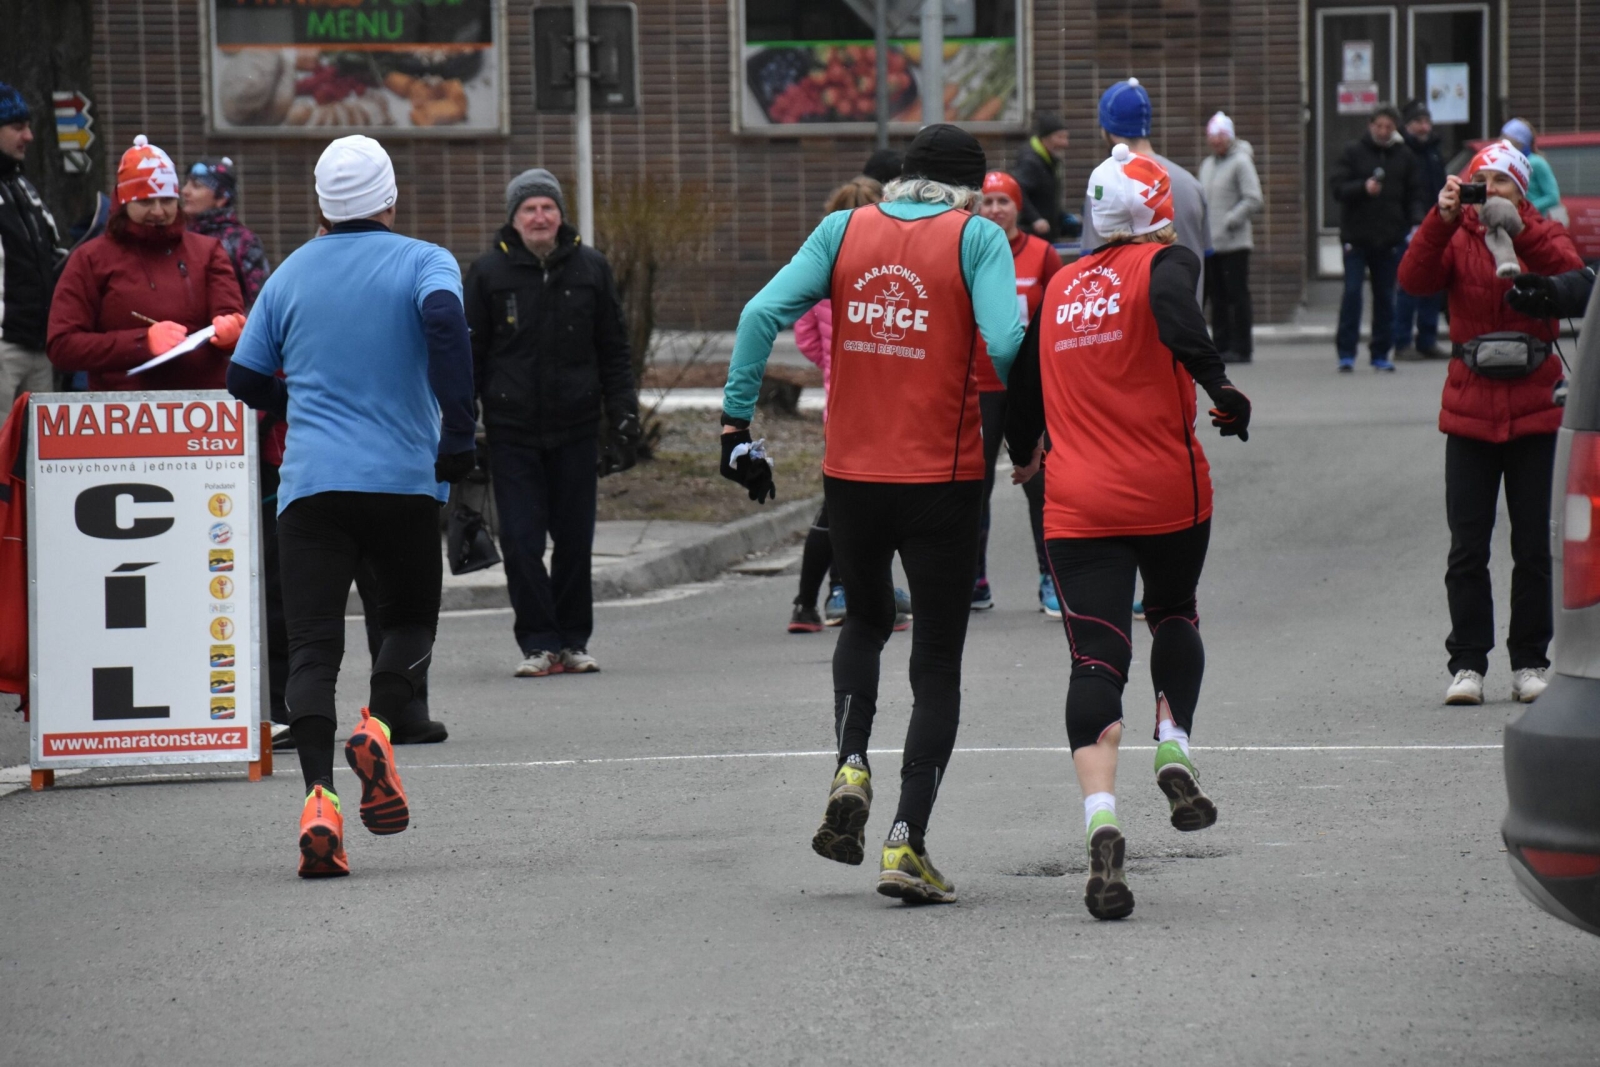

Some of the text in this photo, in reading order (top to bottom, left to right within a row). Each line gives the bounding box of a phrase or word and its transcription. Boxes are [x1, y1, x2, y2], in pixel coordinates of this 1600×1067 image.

[306, 10, 404, 39] MENU
[853, 264, 928, 299] MARATONSTAV
[843, 340, 926, 359] CZECH REPUBLIC
[1054, 330, 1123, 352] CZECH REPUBLIC
[37, 401, 244, 437] MARATON
[186, 436, 238, 451] stav
[40, 458, 245, 475] tělovýchovná jednota Úpice
[49, 731, 242, 751] www.maratonstav.cz
